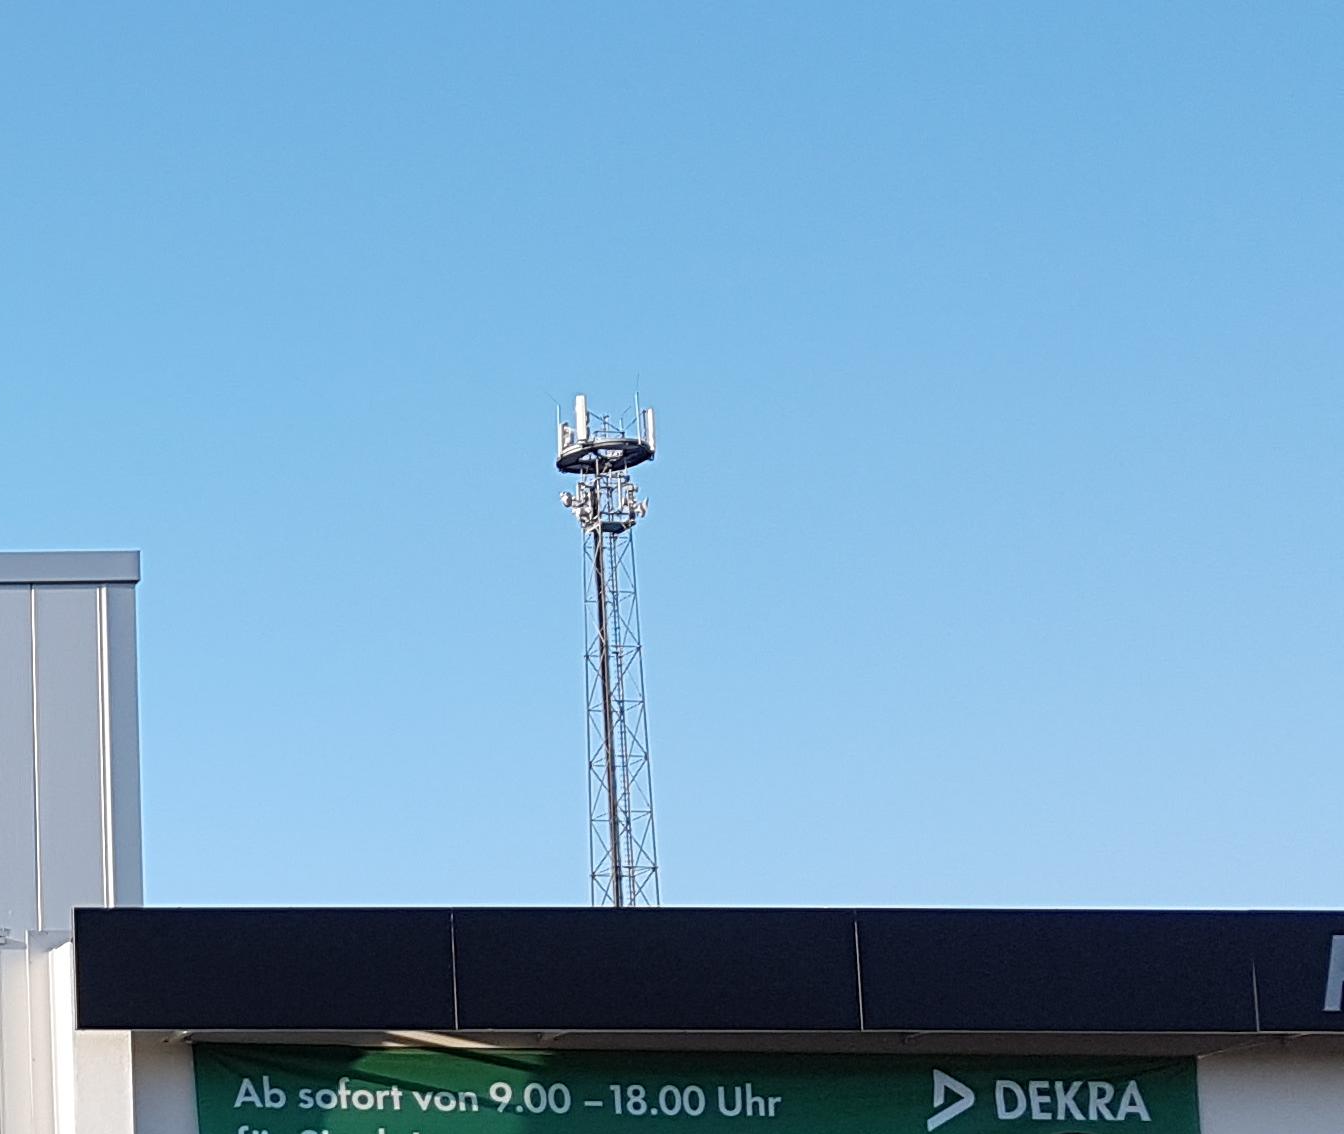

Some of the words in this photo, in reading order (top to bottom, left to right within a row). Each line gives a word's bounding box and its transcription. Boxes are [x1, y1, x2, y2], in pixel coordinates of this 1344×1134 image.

[234, 1078, 286, 1109] Ab
[299, 1077, 402, 1112] sofort
[413, 1091, 479, 1112] von
[489, 1083, 571, 1114] 9.00
[717, 1085, 782, 1118] Uhr
[995, 1080, 1151, 1121] DEKRA
